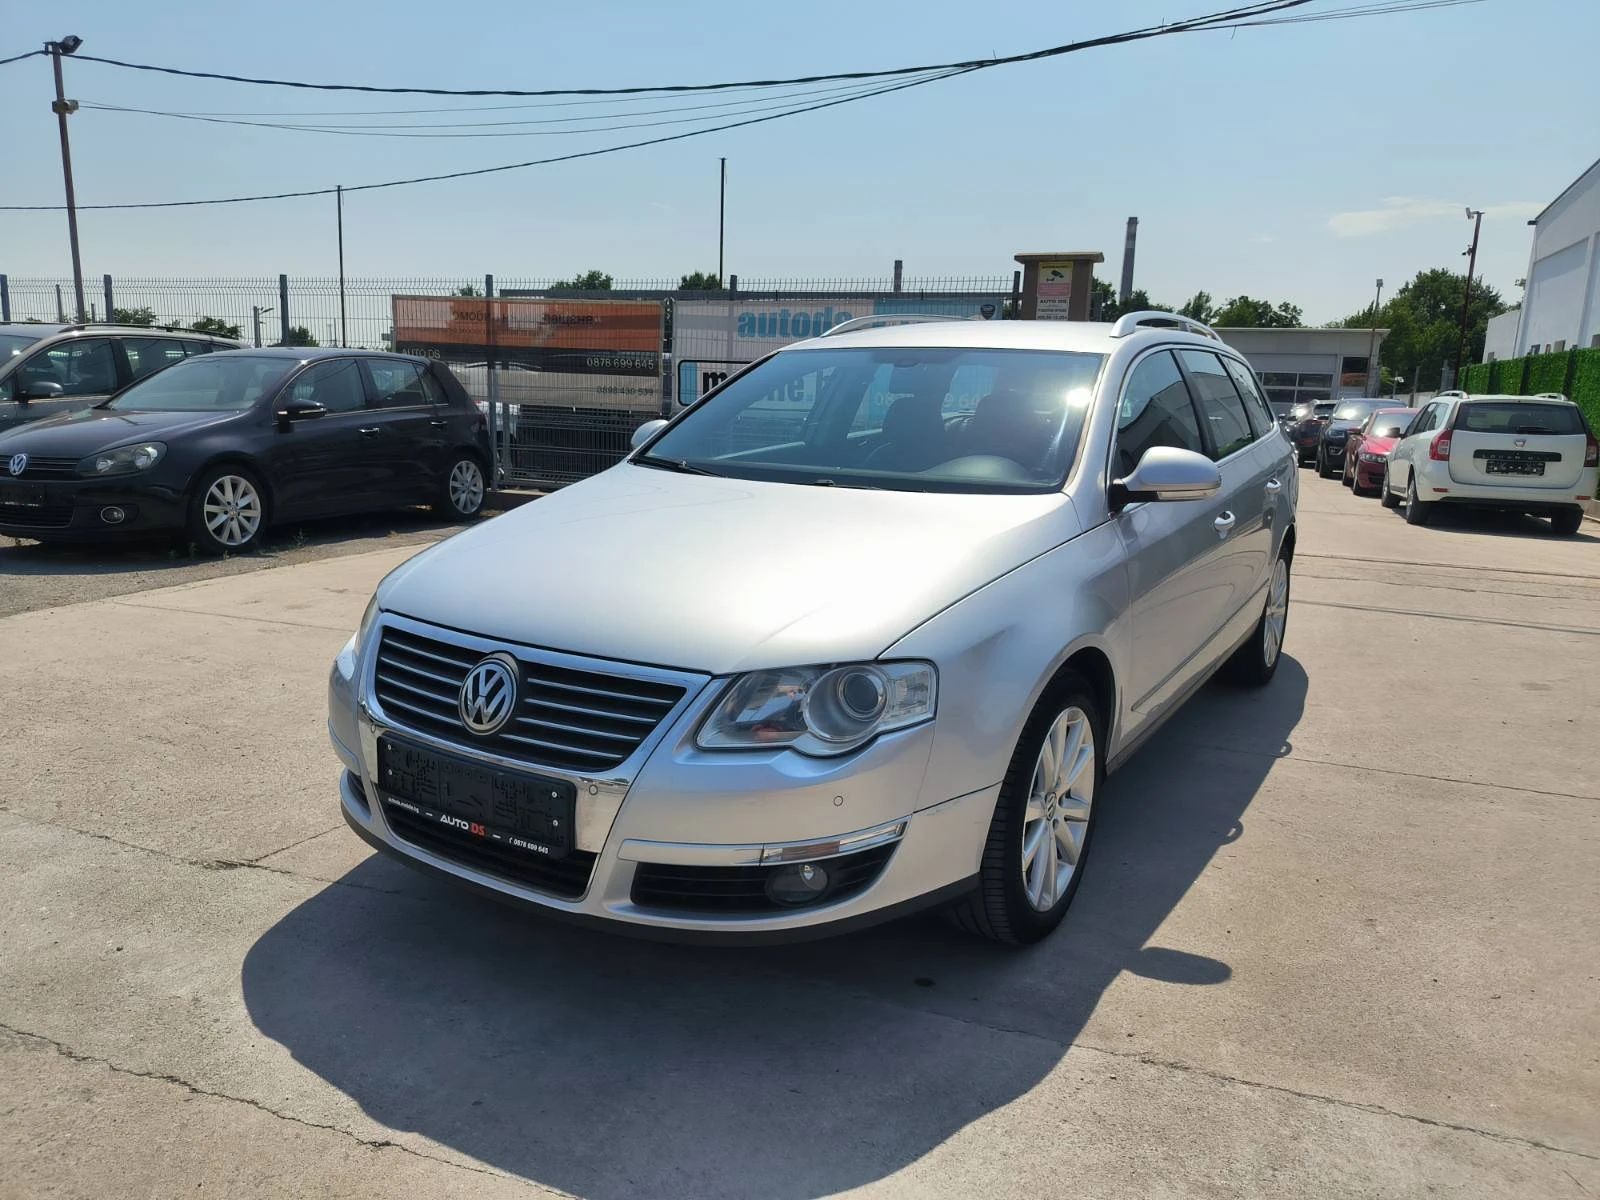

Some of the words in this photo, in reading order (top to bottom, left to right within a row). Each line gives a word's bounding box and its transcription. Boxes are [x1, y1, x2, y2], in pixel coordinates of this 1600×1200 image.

[586, 357, 611, 367] 0878
[613, 358, 633, 369] 699
[440, 814, 469, 831] AUTO
[470, 822, 486, 837] DS
